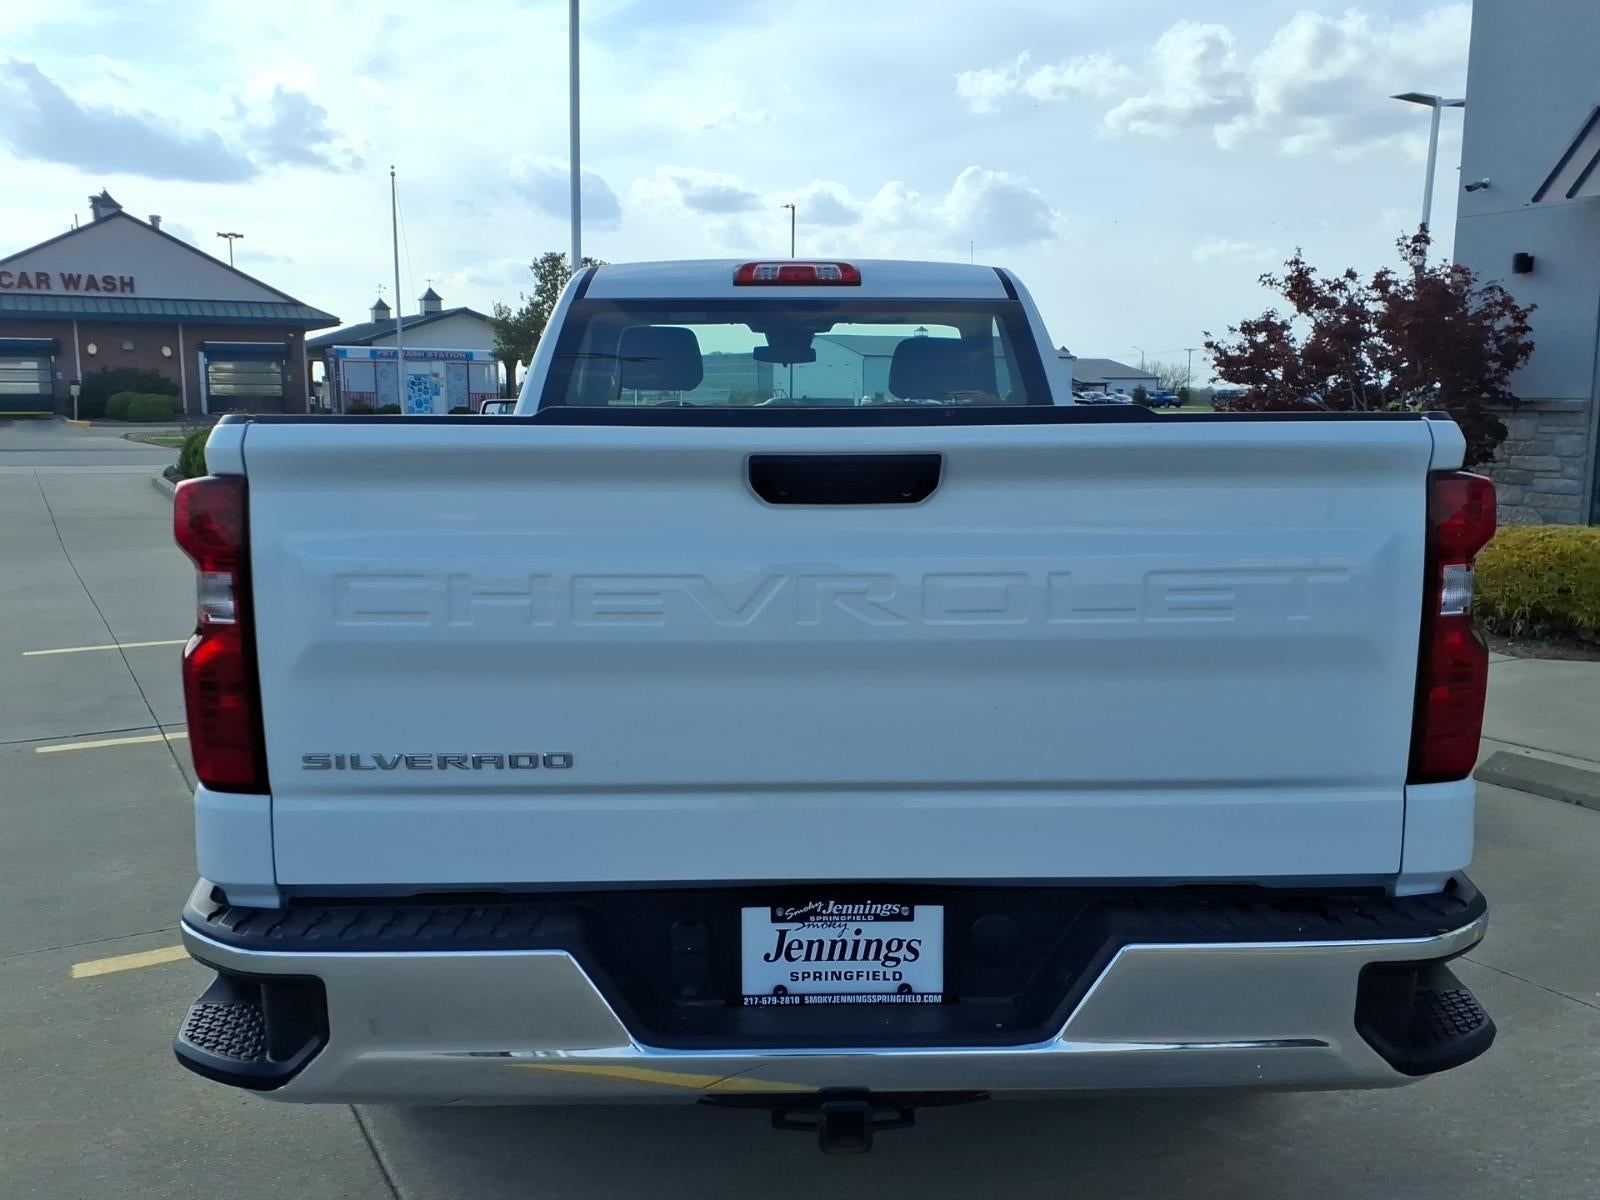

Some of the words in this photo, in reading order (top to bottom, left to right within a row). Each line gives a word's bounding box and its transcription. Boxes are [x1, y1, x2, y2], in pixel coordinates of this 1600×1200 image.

[0, 271, 51, 290] CAR
[60, 272, 135, 293] WASH
[333, 564, 1350, 627] CHEVROLET
[301, 752, 574, 770] SILVERADO
[785, 901, 824, 919] Smoky
[822, 900, 900, 916] Jennings
[763, 928, 922, 968] Jennings
[790, 970, 903, 981] SPRINGFIELD
[804, 994, 942, 1004] SMOKYJENNINGSSPRINGFIELD.COM
